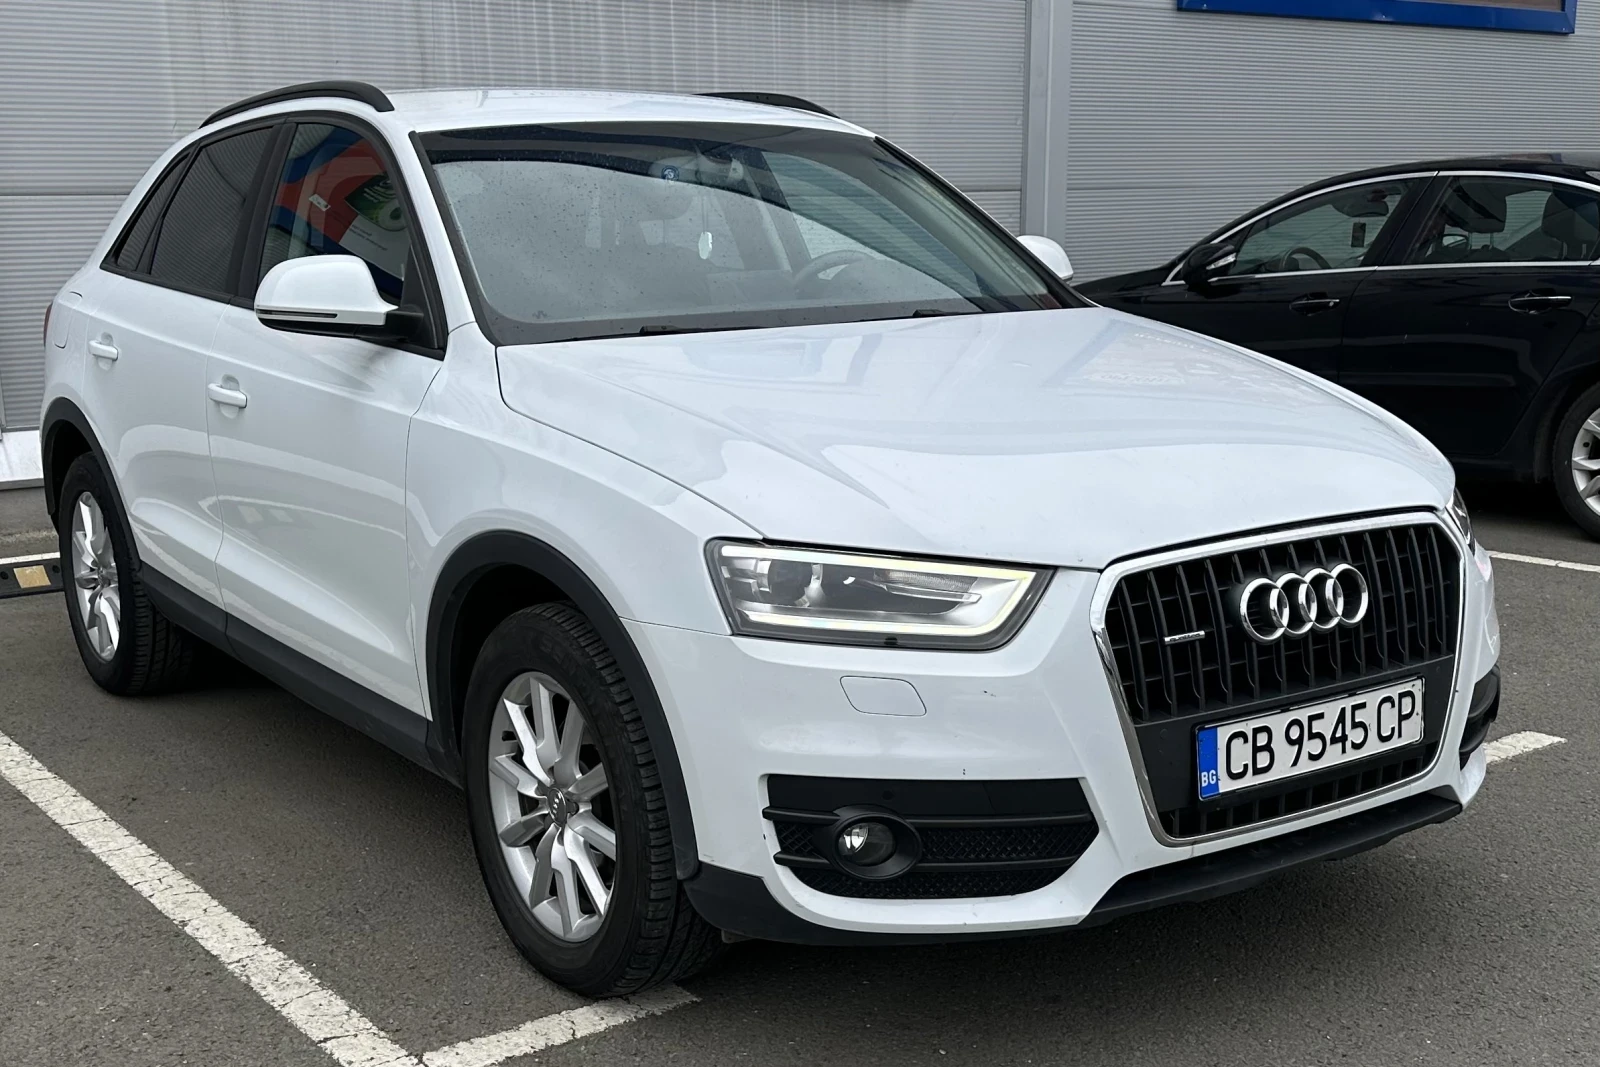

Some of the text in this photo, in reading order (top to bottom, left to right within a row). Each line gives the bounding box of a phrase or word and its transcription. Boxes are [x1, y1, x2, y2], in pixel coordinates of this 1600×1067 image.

[1225, 689, 1417, 781] CB 9545 CP
[1201, 770, 1217, 787] BG
